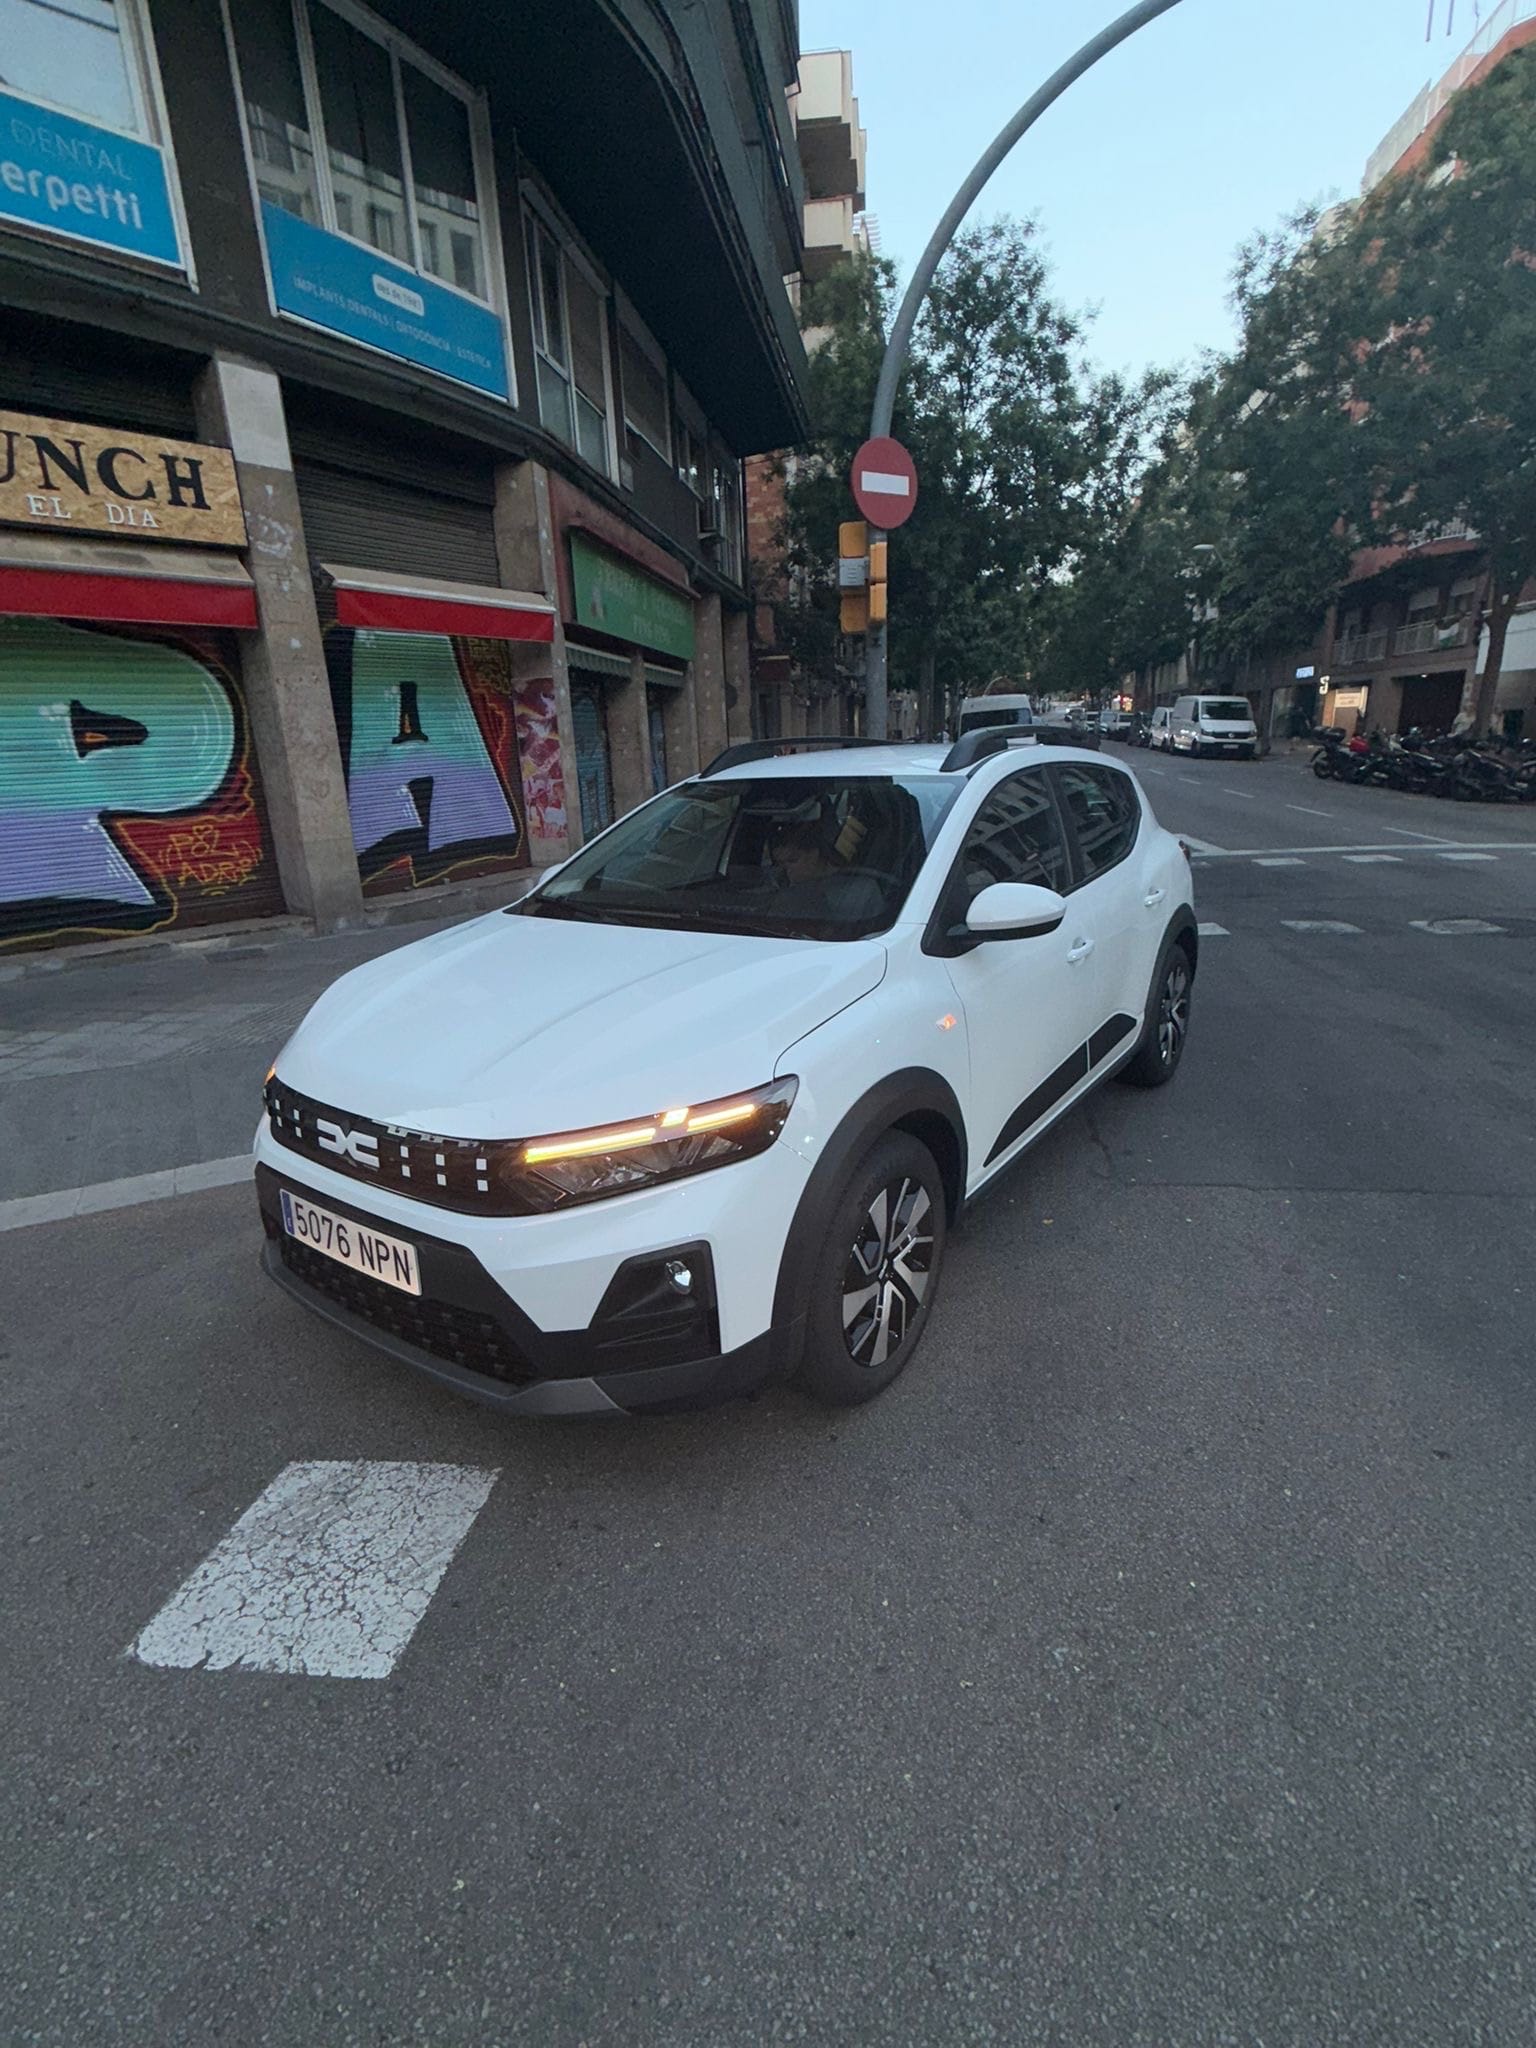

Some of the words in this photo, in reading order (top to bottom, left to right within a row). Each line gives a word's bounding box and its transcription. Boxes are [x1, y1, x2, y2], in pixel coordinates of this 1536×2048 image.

[10, 118, 132, 181] DENTAL
[1, 159, 143, 229] erpetti
[27, 493, 71, 519] EL
[105, 503, 159, 528] DIA
[294, 1201, 350, 1259] 5076
[358, 1231, 412, 1286] NPN
